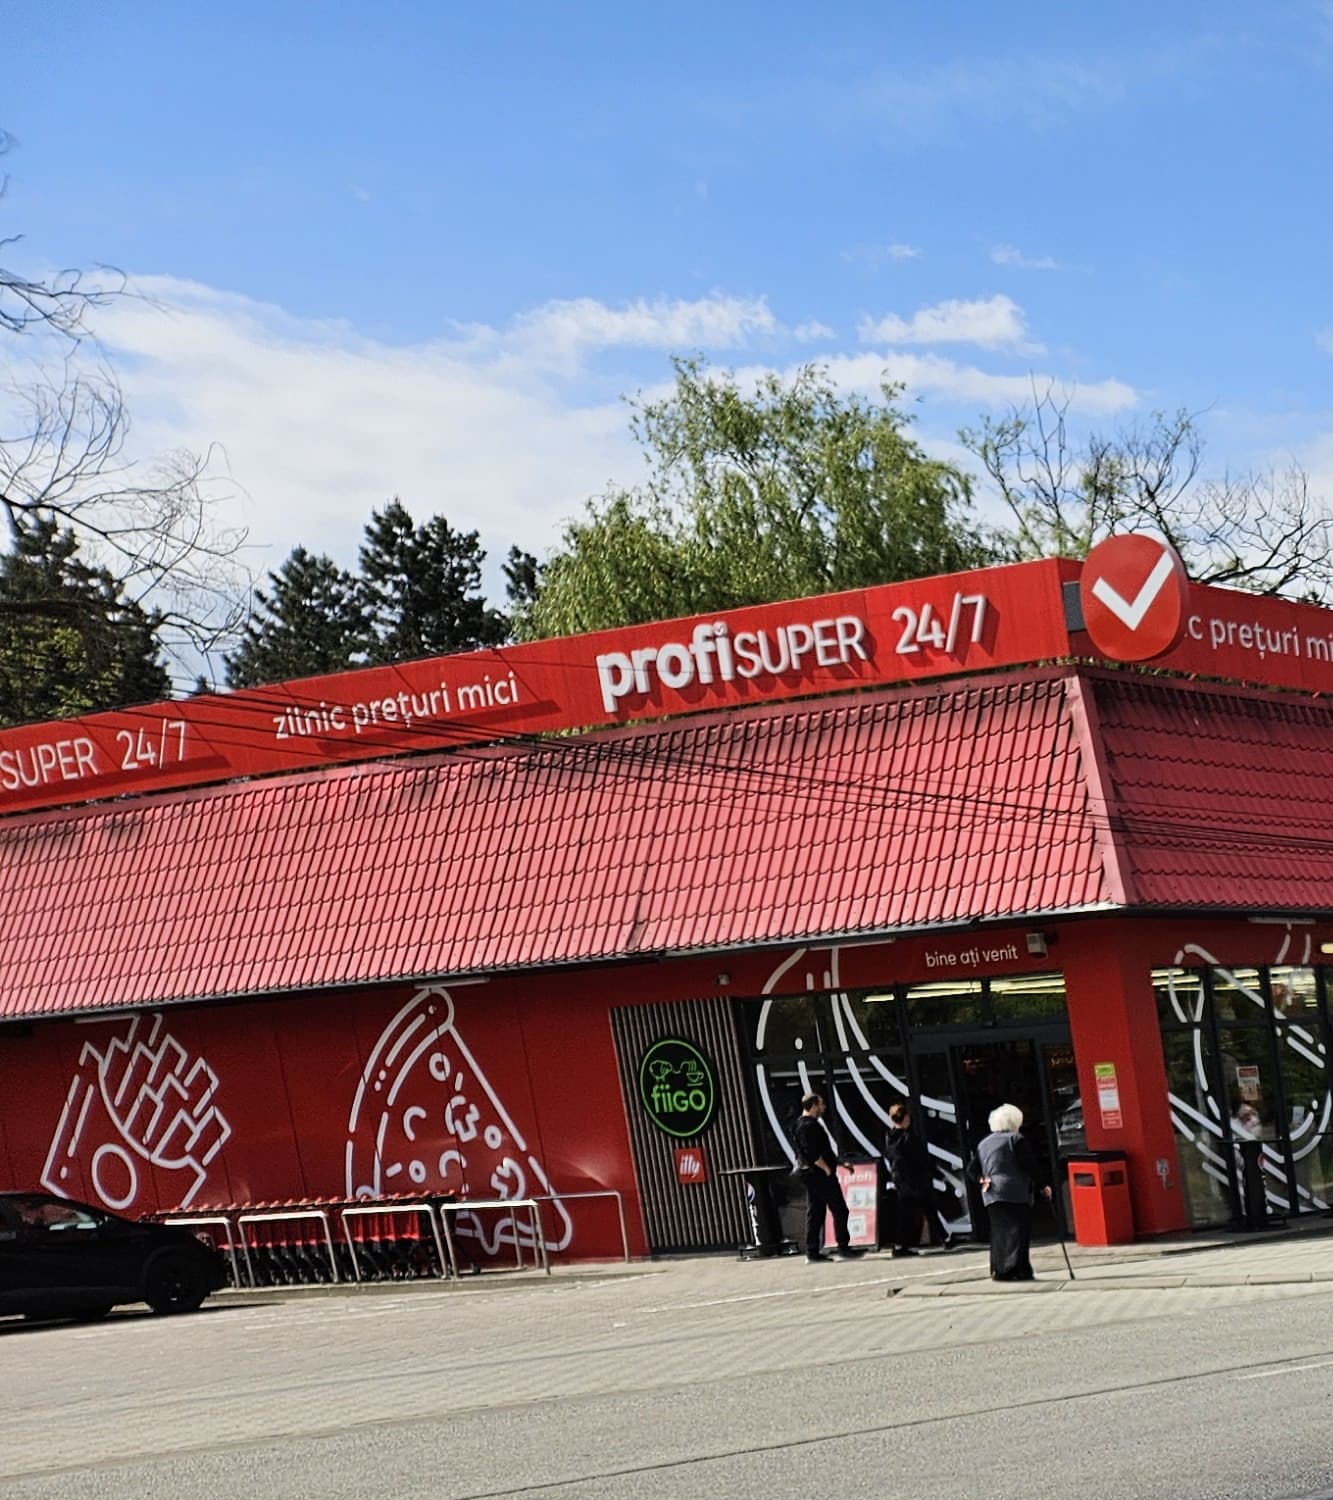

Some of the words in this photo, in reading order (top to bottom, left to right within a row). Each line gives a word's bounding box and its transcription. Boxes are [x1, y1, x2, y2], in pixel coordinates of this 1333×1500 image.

[891, 592, 987, 655] 24/7
[1211, 617, 1300, 660] prețuri
[273, 701, 347, 739] zilnic
[352, 682, 451, 734] prețuri
[457, 671, 519, 711] mici
[116, 717, 187, 771] 24/7
[925, 951, 957, 968] bine
[960, 946, 980, 968] ați
[983, 944, 1019, 962] venit
